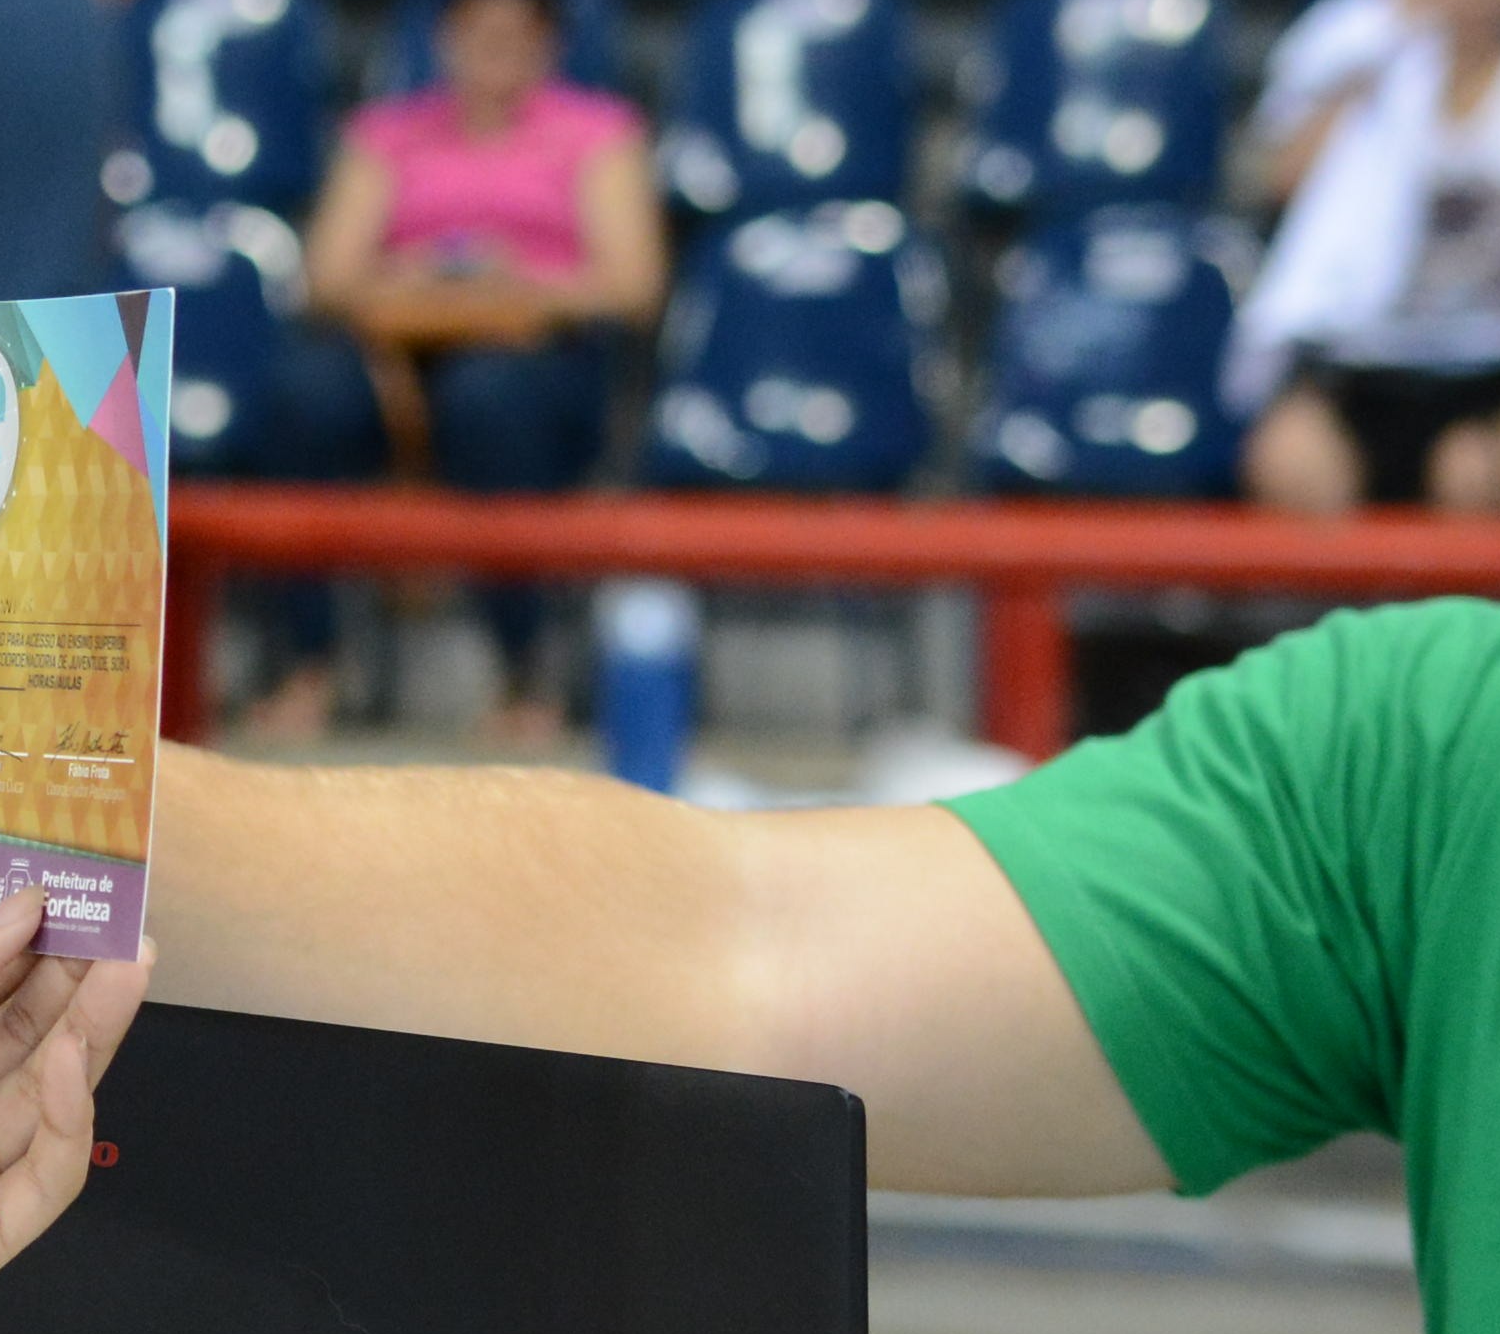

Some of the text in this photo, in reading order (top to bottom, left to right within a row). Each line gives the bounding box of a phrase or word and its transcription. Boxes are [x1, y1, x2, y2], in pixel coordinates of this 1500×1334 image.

[7, 632, 25, 647] PARA
[26, 633, 56, 648] ACESSO
[68, 634, 93, 649] ENSINO
[58, 655, 67, 668] DE
[91, 763, 110, 779] Frota
[42, 870, 113, 893] Prefeitura de
